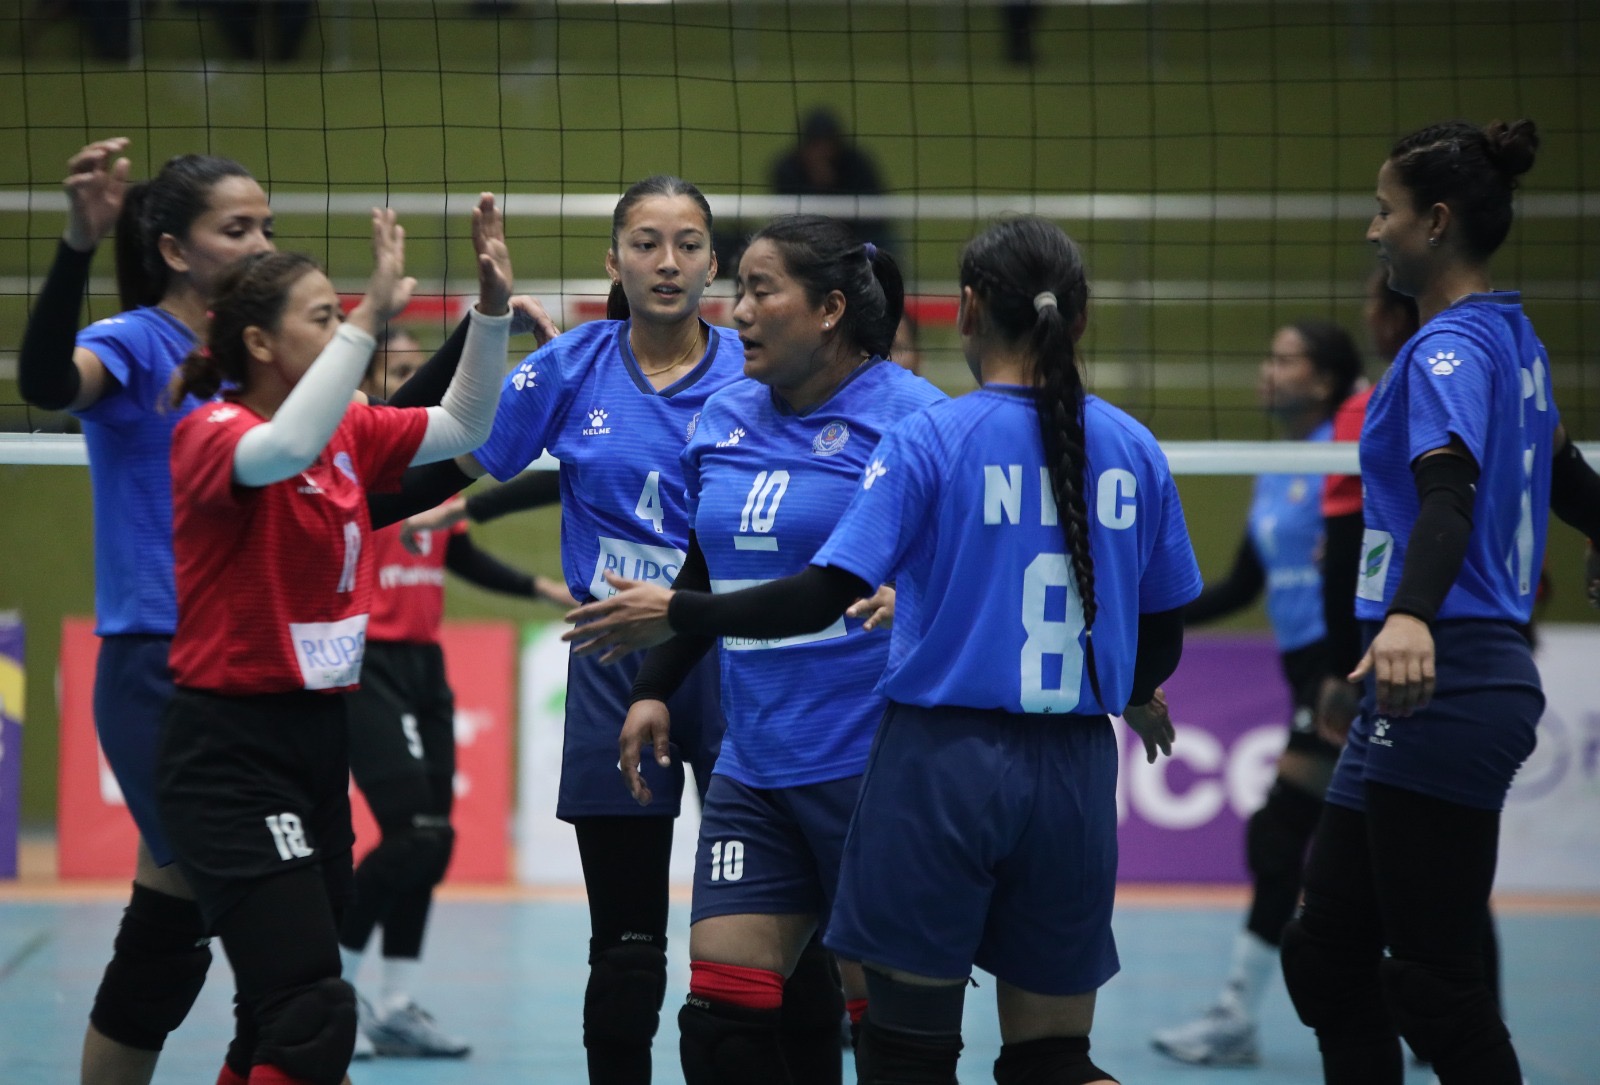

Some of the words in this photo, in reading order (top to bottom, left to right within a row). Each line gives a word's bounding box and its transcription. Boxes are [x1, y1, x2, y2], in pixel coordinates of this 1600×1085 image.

[582, 427, 611, 436] KELME
[635, 470, 664, 534] 4
[739, 470, 790, 533] 10
[1019, 552, 1085, 713] 8
[264, 812, 315, 861] 18
[711, 840, 744, 881] 10
